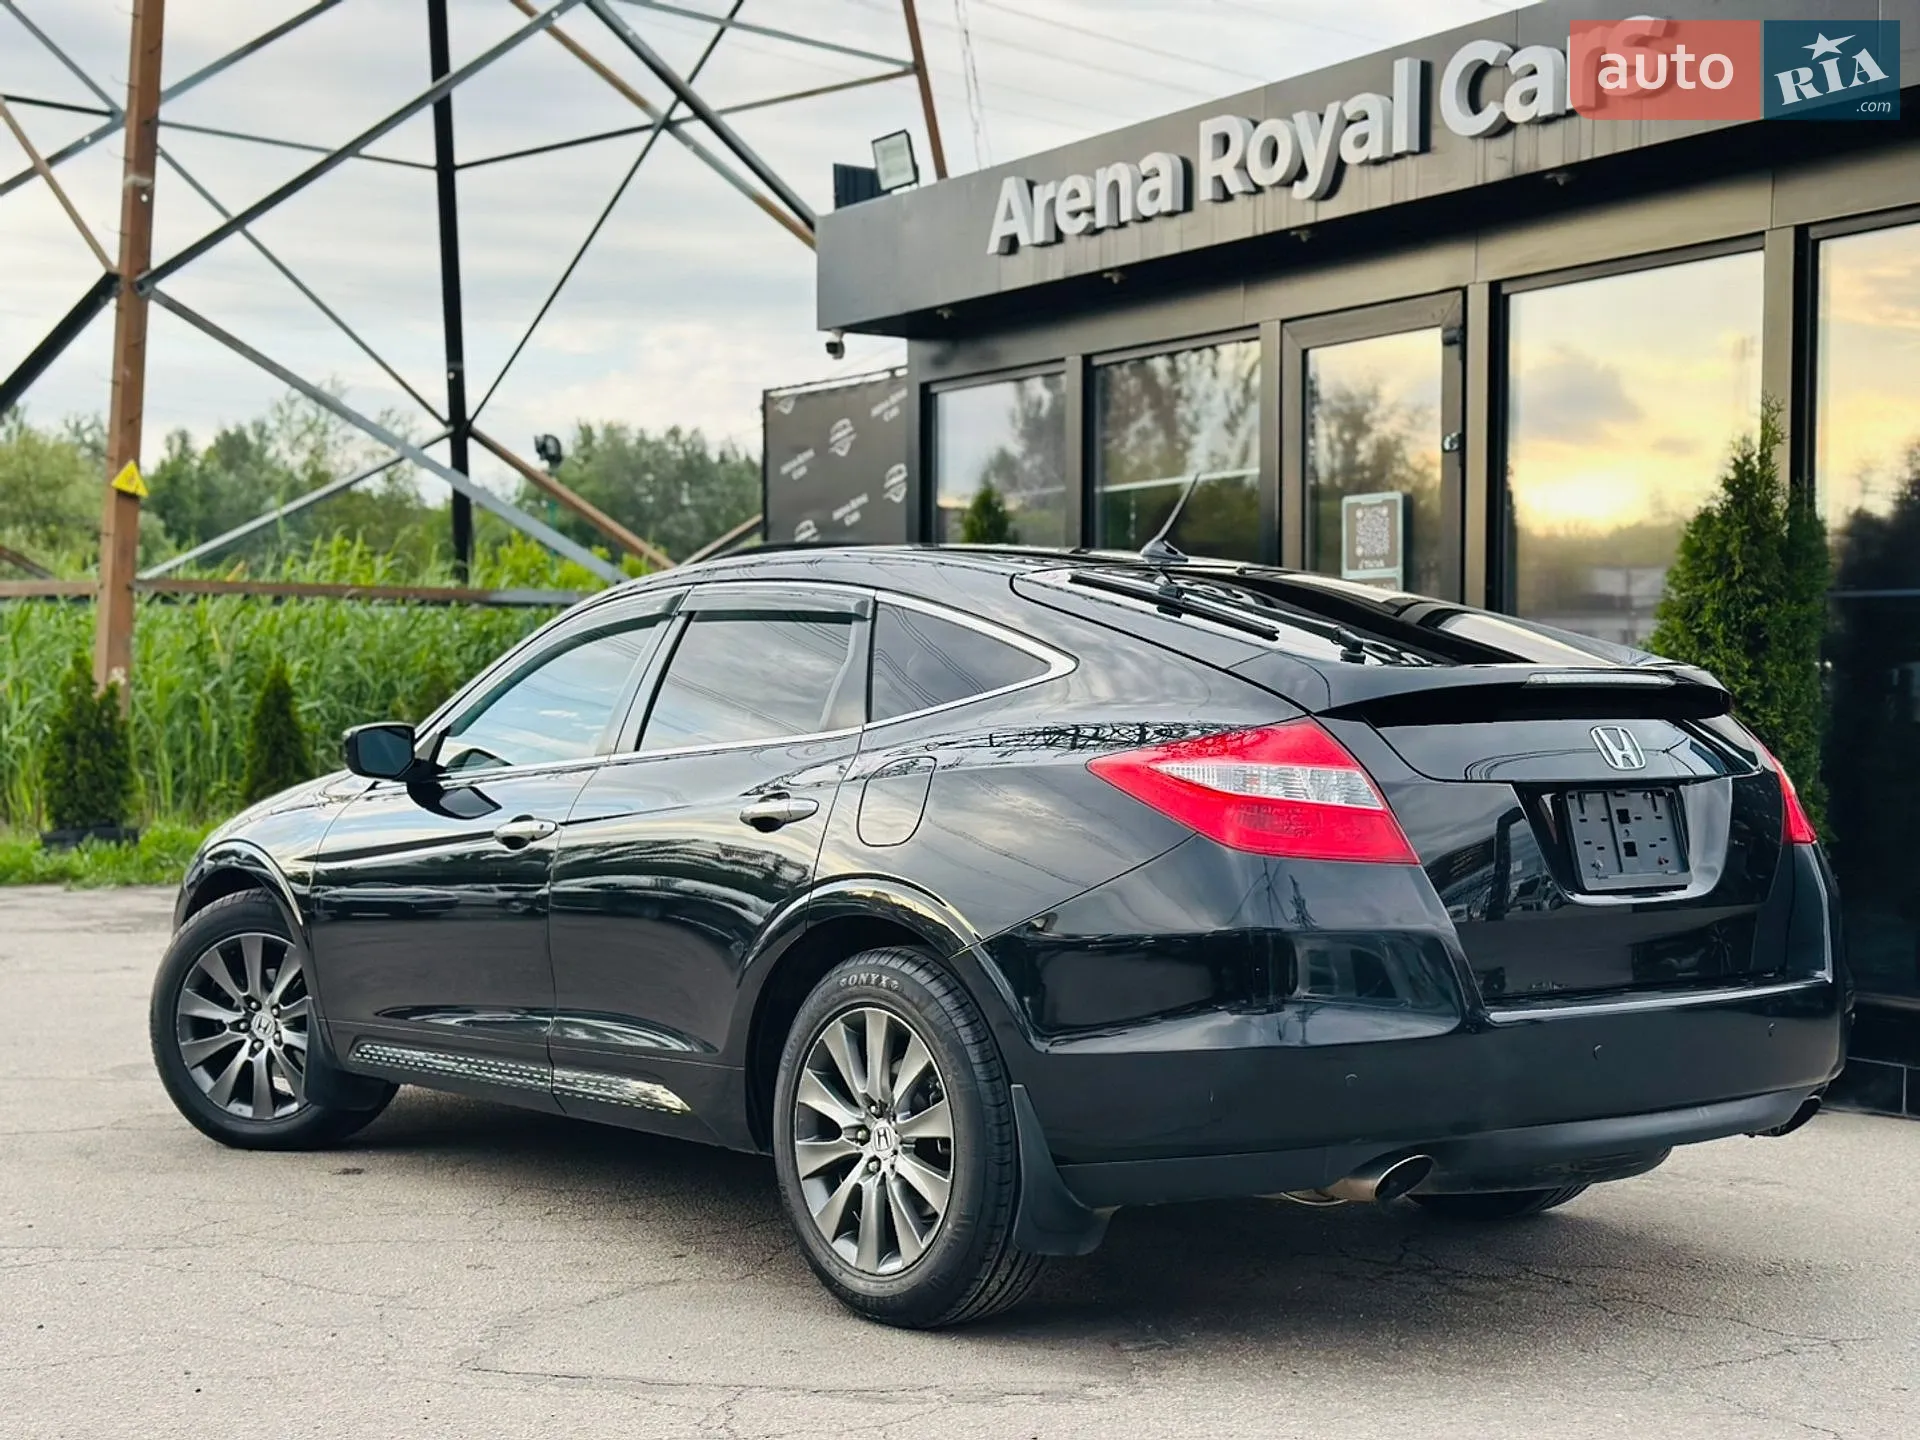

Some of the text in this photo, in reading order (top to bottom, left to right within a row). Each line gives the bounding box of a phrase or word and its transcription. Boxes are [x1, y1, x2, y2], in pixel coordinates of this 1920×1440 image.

[987, 152, 1184, 255] Arena
[1200, 57, 1421, 200] Royal
[848, 973, 892, 988] ONYX
